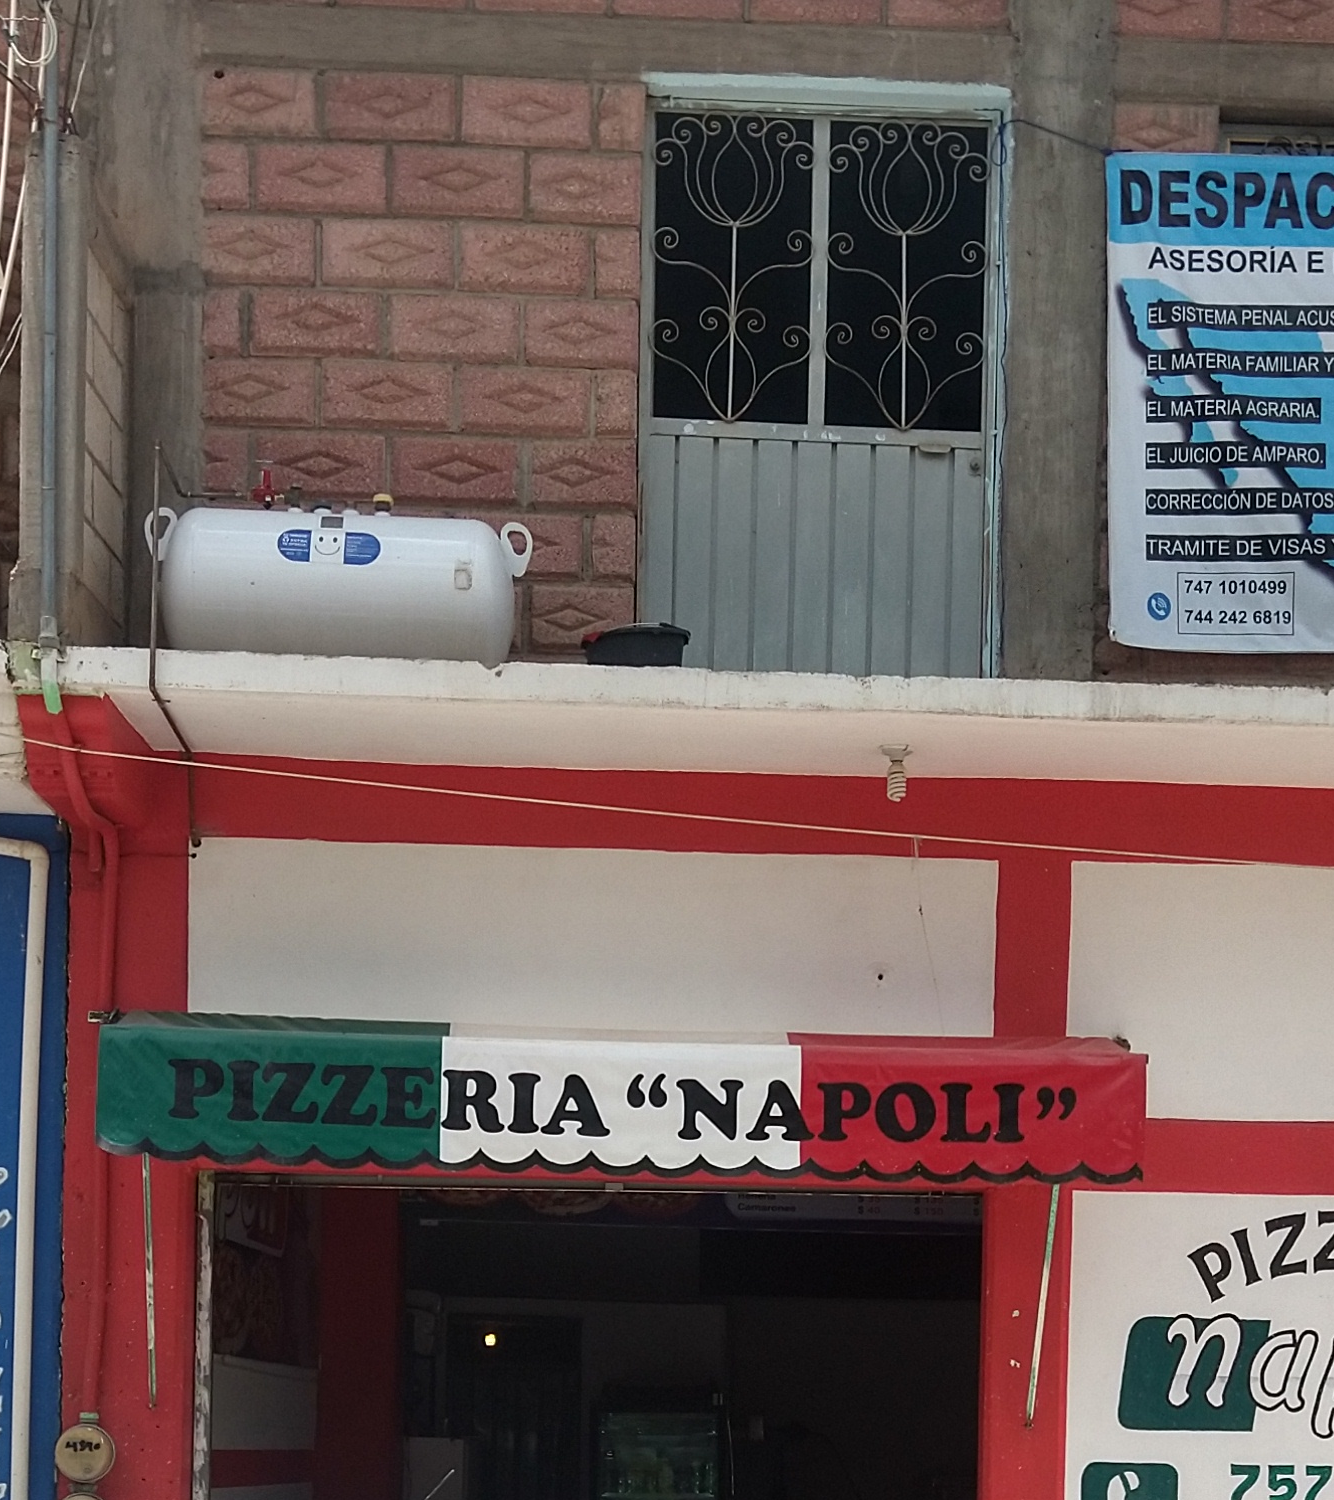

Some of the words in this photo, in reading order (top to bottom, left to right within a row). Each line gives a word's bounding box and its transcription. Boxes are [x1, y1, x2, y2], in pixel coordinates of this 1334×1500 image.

[1148, 247, 1297, 273] ASESORÍA
[1307, 251, 1324, 273] E
[1148, 310, 1166, 324] EL
[1171, 306, 1238, 325] SISTEMA
[1242, 310, 1293, 326] PENAL
[1147, 355, 1166, 371] EL
[1171, 352, 1241, 372] MATERIA
[1246, 355, 1319, 372] FAMILIAR
[1323, 357, 1334, 372] Y
[1147, 401, 1165, 417] EL
[1171, 399, 1242, 417] MATERIA
[1246, 401, 1320, 418] AGRARIA.
[1146, 448, 1165, 463] EL
[1169, 446, 1222, 464] JUICIO
[1226, 446, 1248, 462] DE
[1252, 446, 1324, 464] AMPARO.
[1146, 490, 1251, 510] CORRECCIÓN
[1255, 492, 1277, 509] DE
[1281, 492, 1334, 509] DATOS
[1146, 539, 1230, 556] TRAMITE
[1236, 540, 1262, 556] DE
[1268, 538, 1326, 556] VISAS
[1184, 580, 1212, 595] 747
[1218, 580, 1287, 595] 1010499
[1184, 610, 1213, 624] 744
[1218, 610, 1247, 624] 242
[1253, 610, 1291, 625] 6819
[167, 1058, 611, 1137] PIZZERIA
